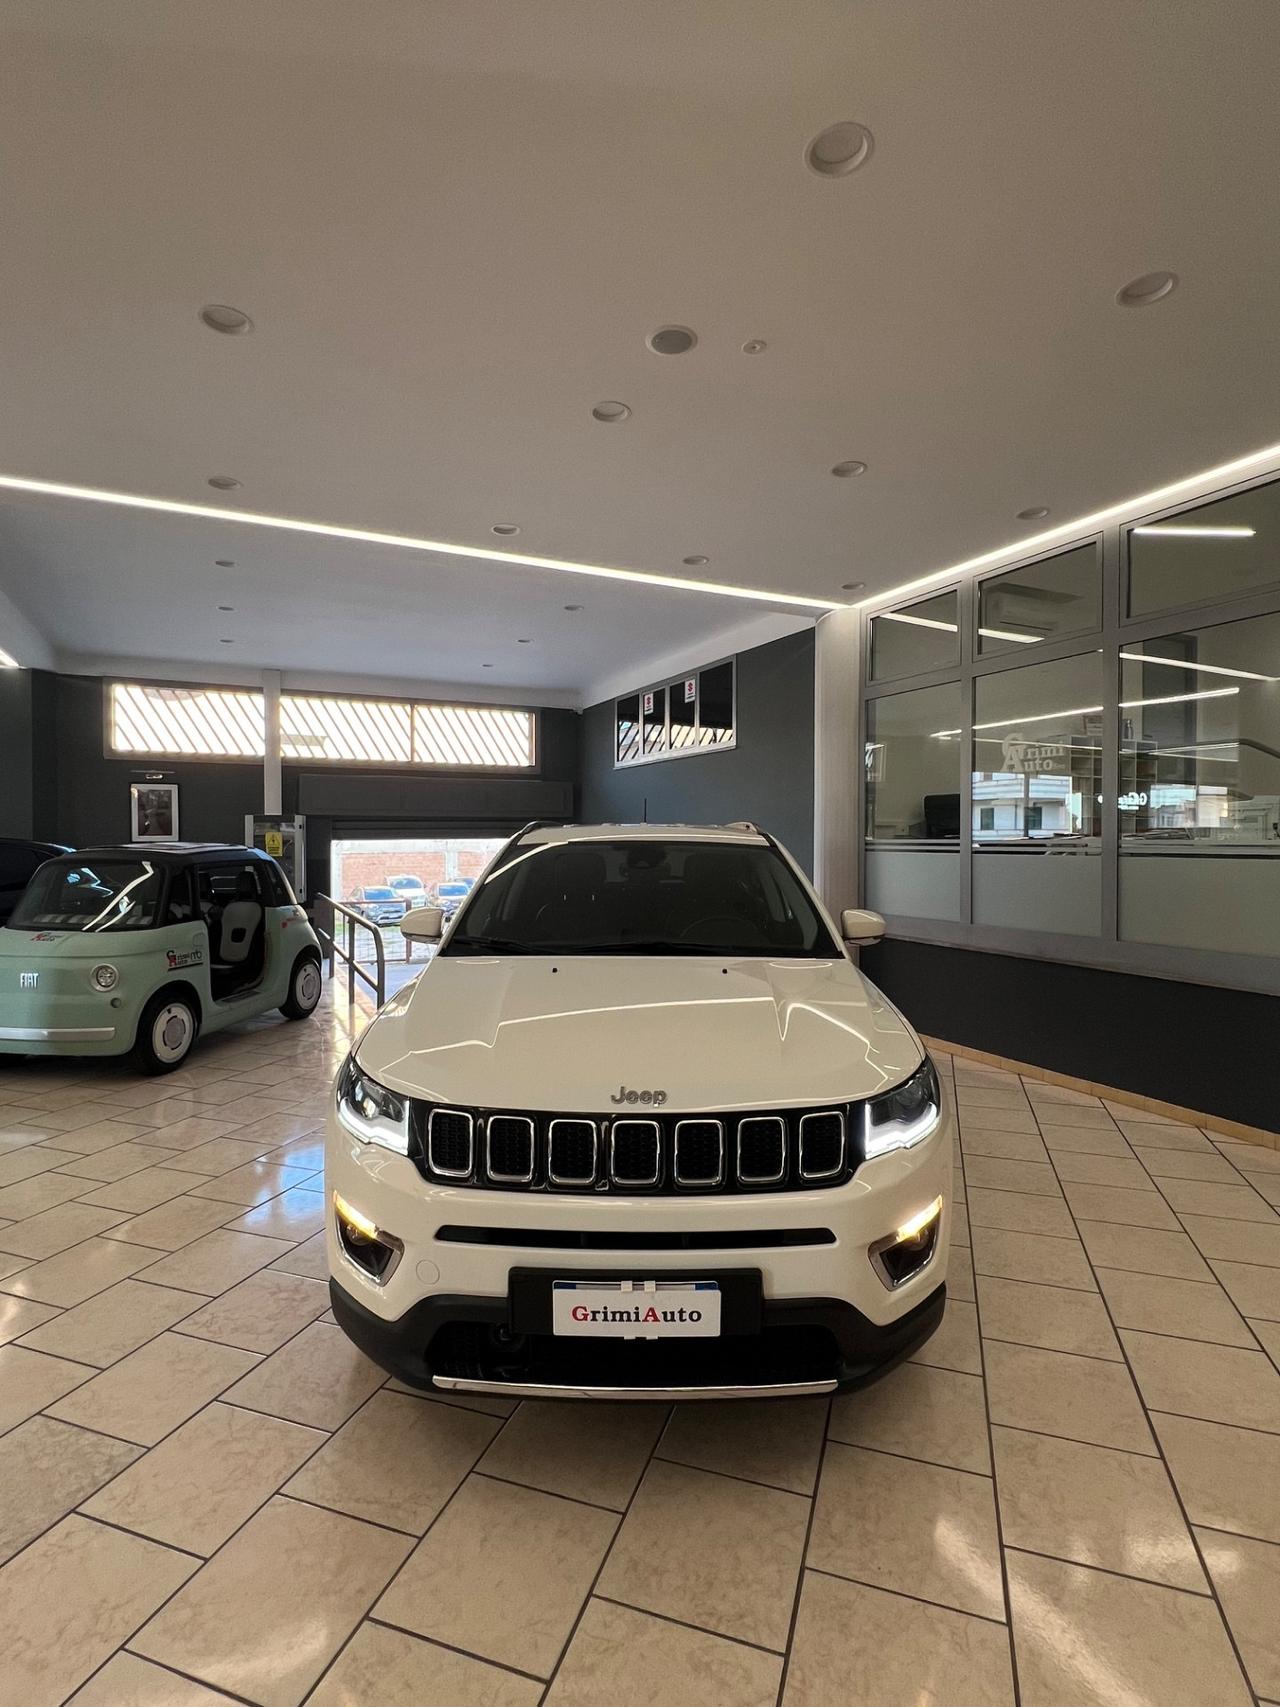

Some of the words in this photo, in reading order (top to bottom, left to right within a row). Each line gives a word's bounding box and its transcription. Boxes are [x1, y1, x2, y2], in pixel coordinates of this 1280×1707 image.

[1002, 732, 1065, 760] Grimi
[1001, 745, 1053, 772] Auto
[20, 972, 39, 989] FIAT
[610, 1086, 668, 1107] Jeep
[571, 1306, 703, 1323] GrimiAuto
